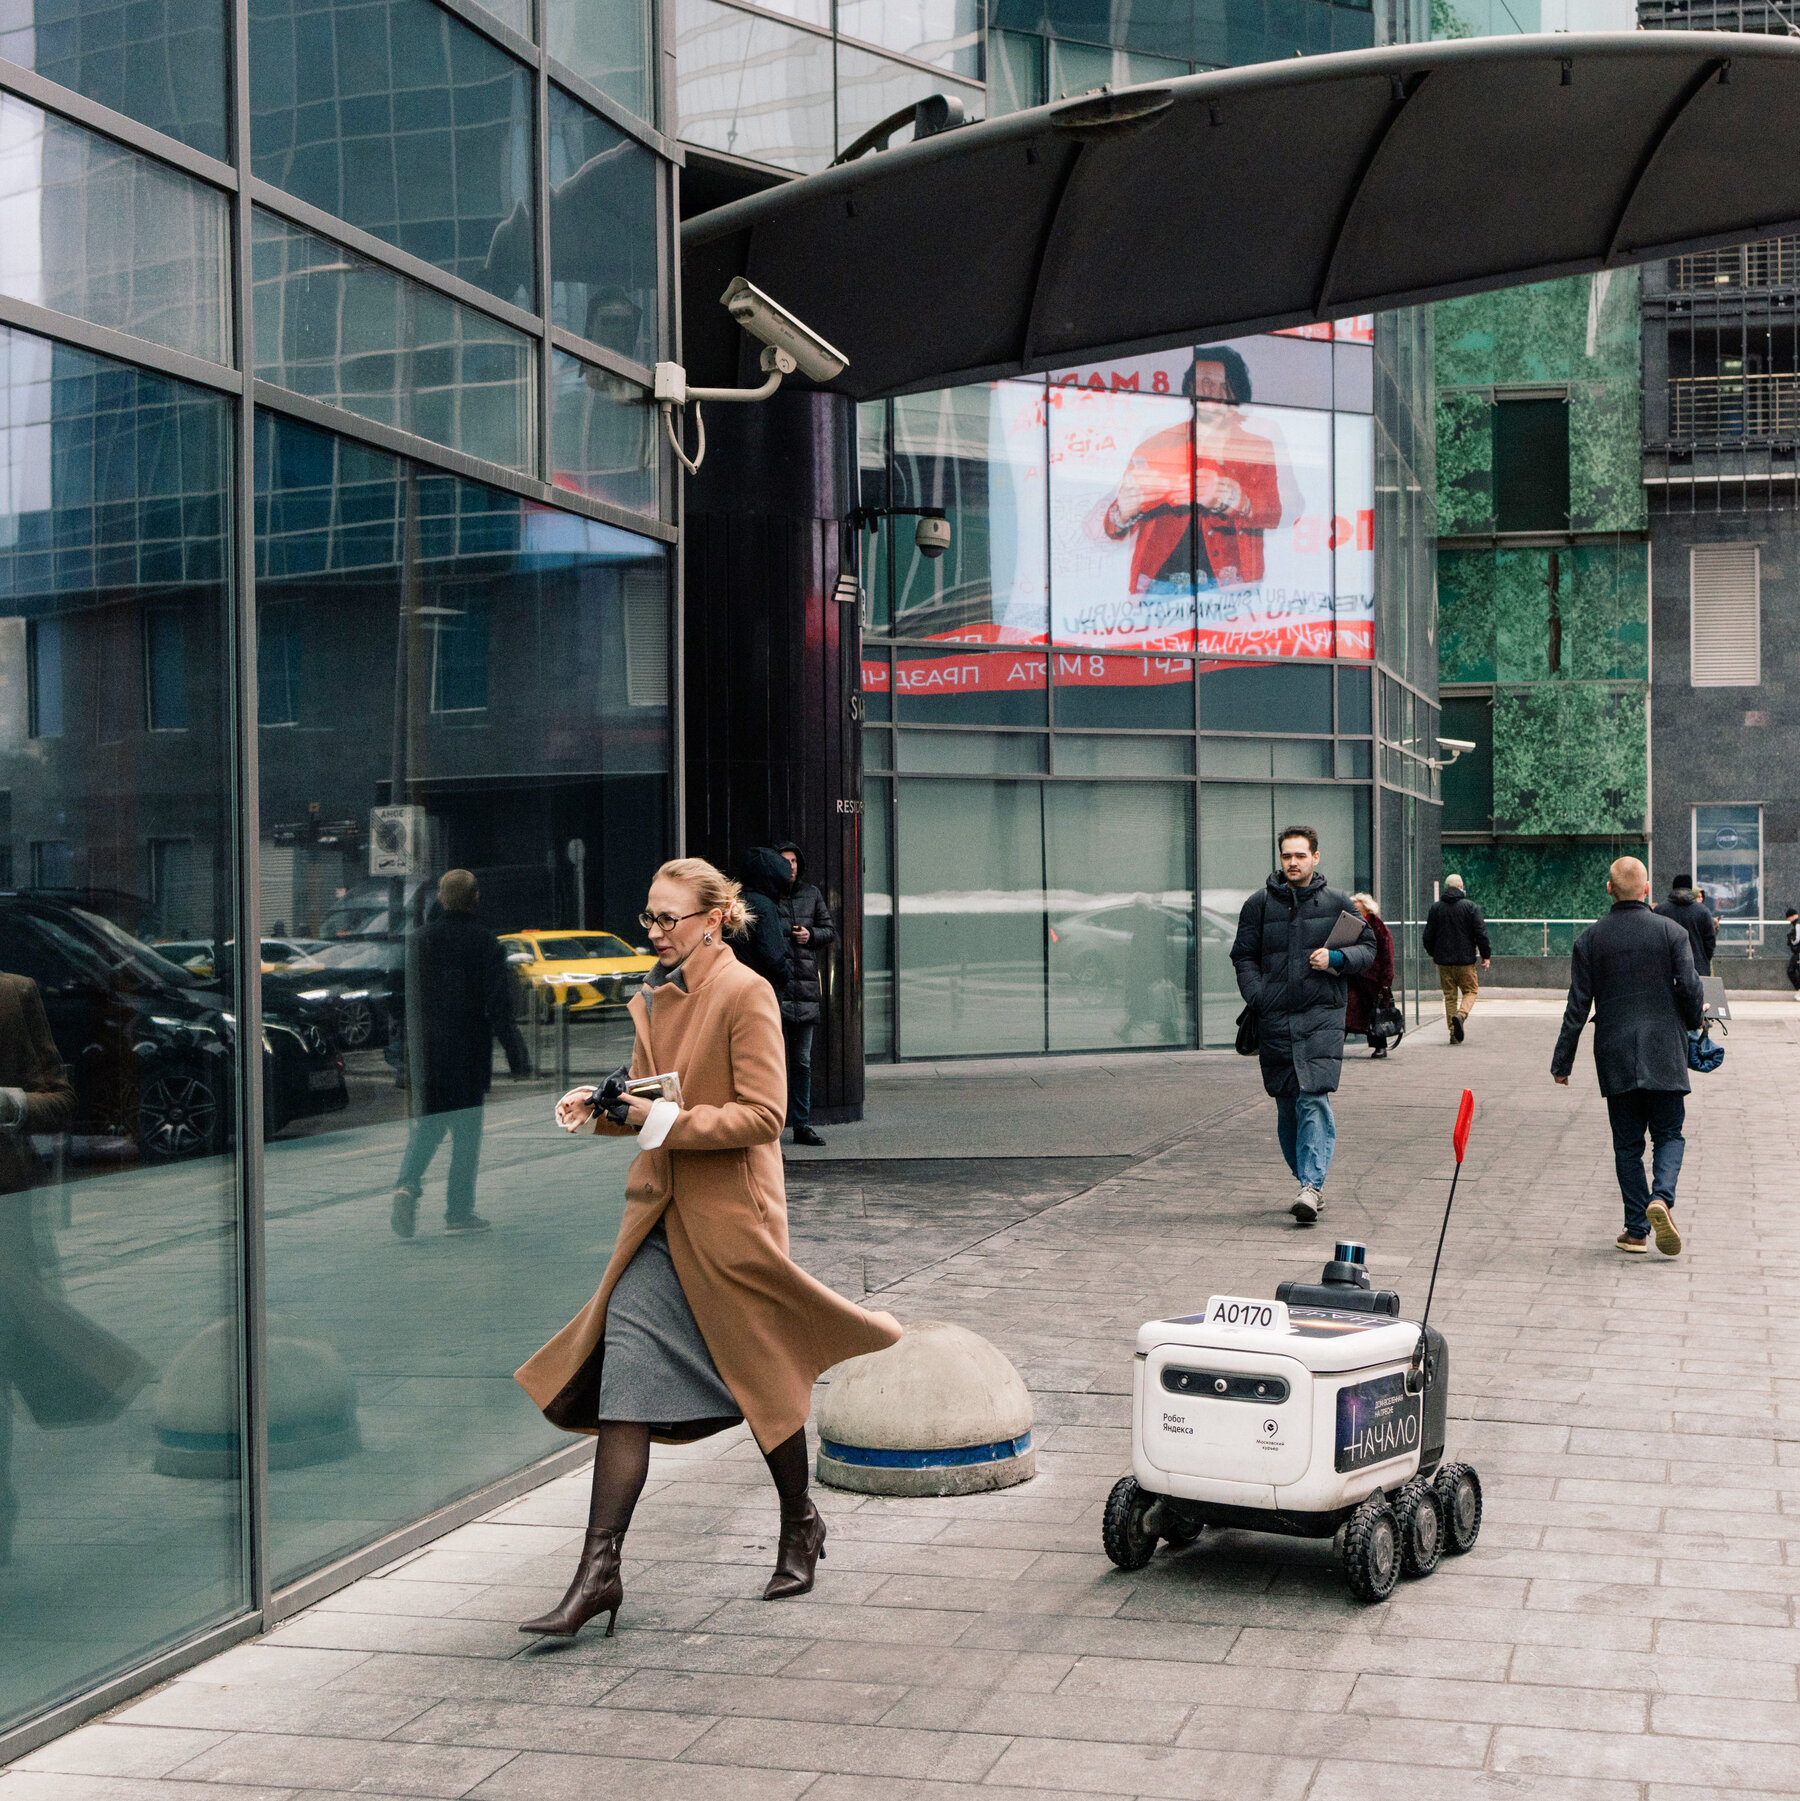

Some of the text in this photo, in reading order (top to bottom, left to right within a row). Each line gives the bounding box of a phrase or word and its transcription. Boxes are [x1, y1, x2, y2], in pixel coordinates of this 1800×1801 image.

[1213, 1303, 1272, 1327] A0170
[1163, 1412, 1186, 1424] Робот
[1162, 1422, 1194, 1435] Яндекса
[1343, 1404, 1417, 1462] НАЧАЛО
